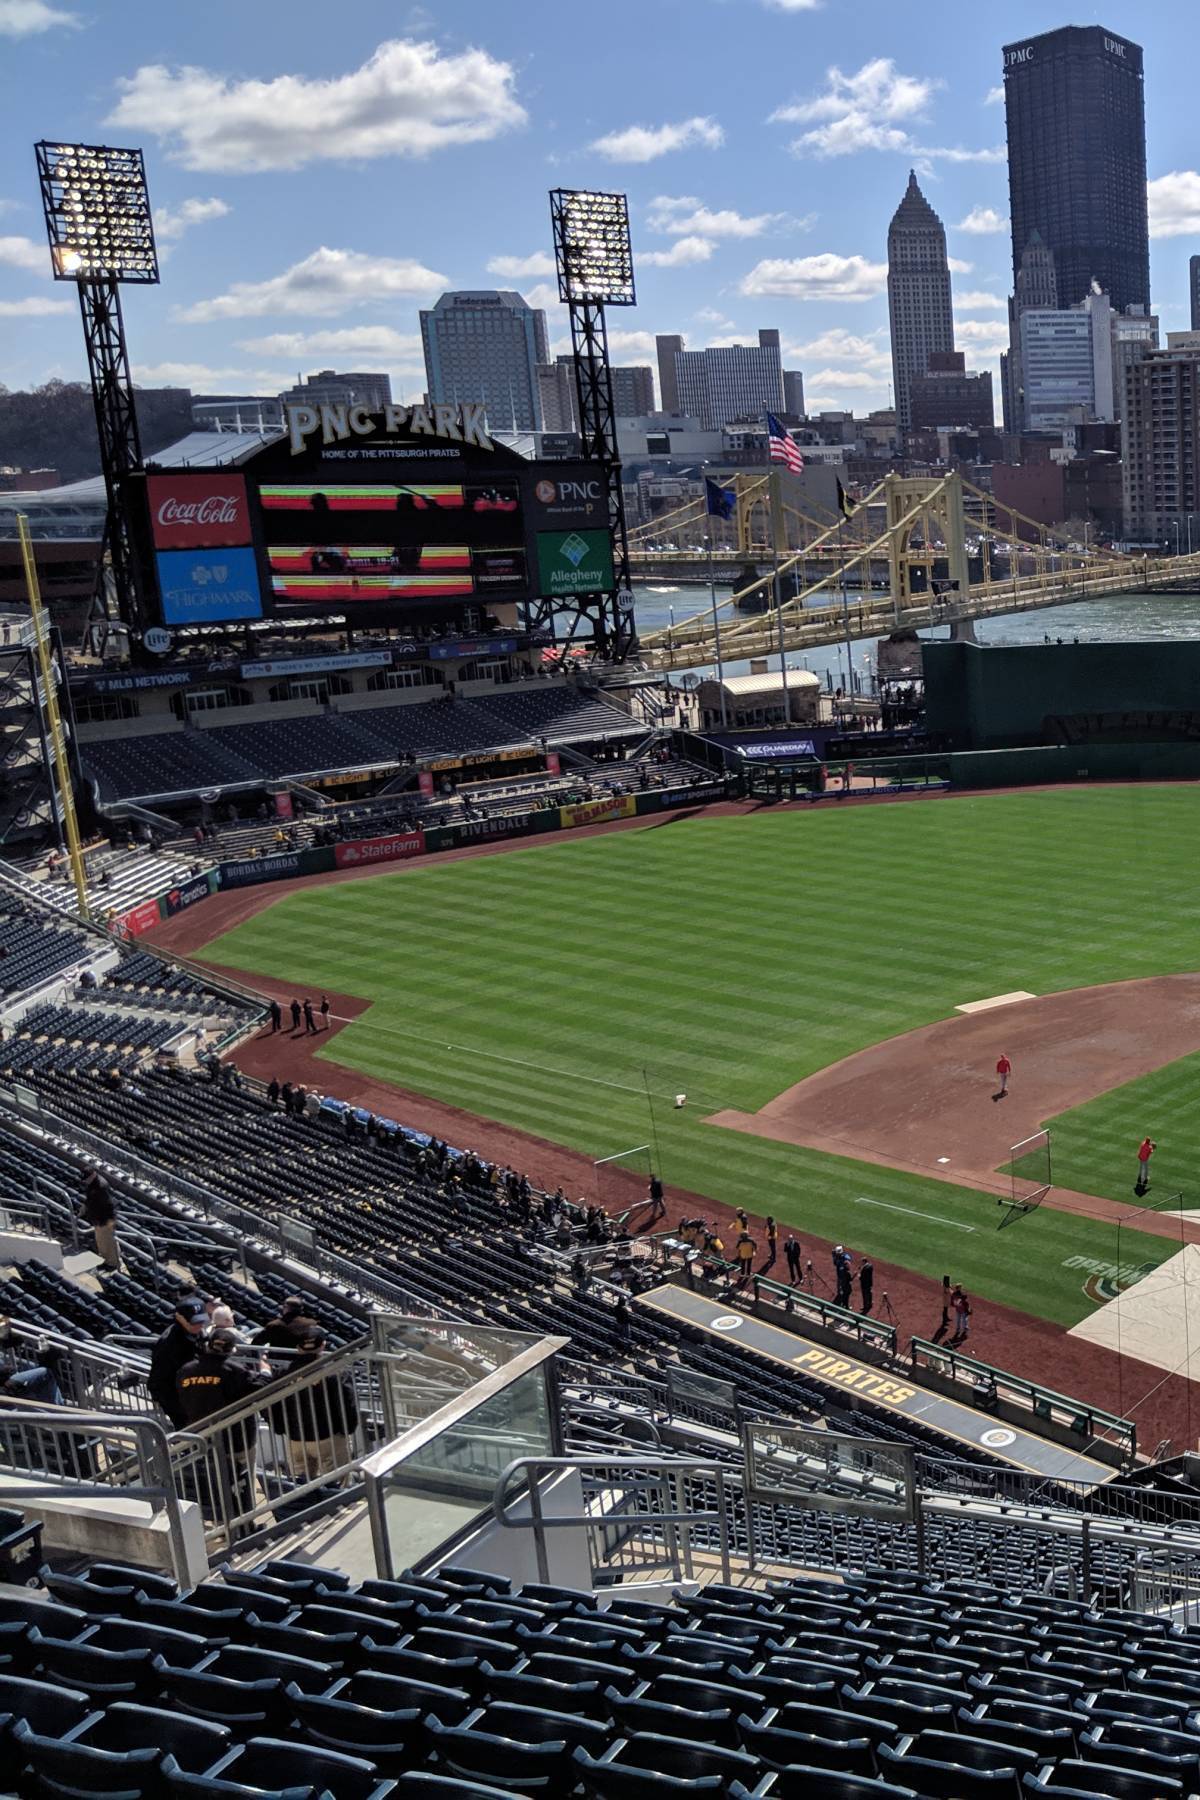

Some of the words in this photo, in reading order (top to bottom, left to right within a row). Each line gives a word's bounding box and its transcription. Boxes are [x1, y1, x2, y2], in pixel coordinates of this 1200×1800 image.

[1003, 46, 1034, 66] UPMC
[1104, 36, 1127, 59] UPMC
[454, 296, 501, 305] Federated
[286, 403, 377, 457] PNC
[384, 403, 495, 452] PARK
[321, 450, 347, 459] HOME
[347, 450, 358, 458] OF
[361, 449, 377, 458] THE
[378, 449, 428, 458] PITTSBURGH
[429, 449, 461, 457] PIRATES
[557, 480, 601, 501] PNC
[158, 496, 240, 526] Coca-Cola
[551, 568, 603, 583] Allegheny
[109, 678, 133, 690] MLB
[135, 672, 192, 688] NETWORK
[475, 755, 497, 765] LIGHT
[342, 773, 364, 783] LIGHT
[460, 816, 529, 838] RIVENDALE
[264, 857, 299, 871] BORDAS
[180, 883, 208, 906] Fanatics
[181, 1376, 222, 1388] STAFF
[791, 1349, 917, 1404] PIRATES
